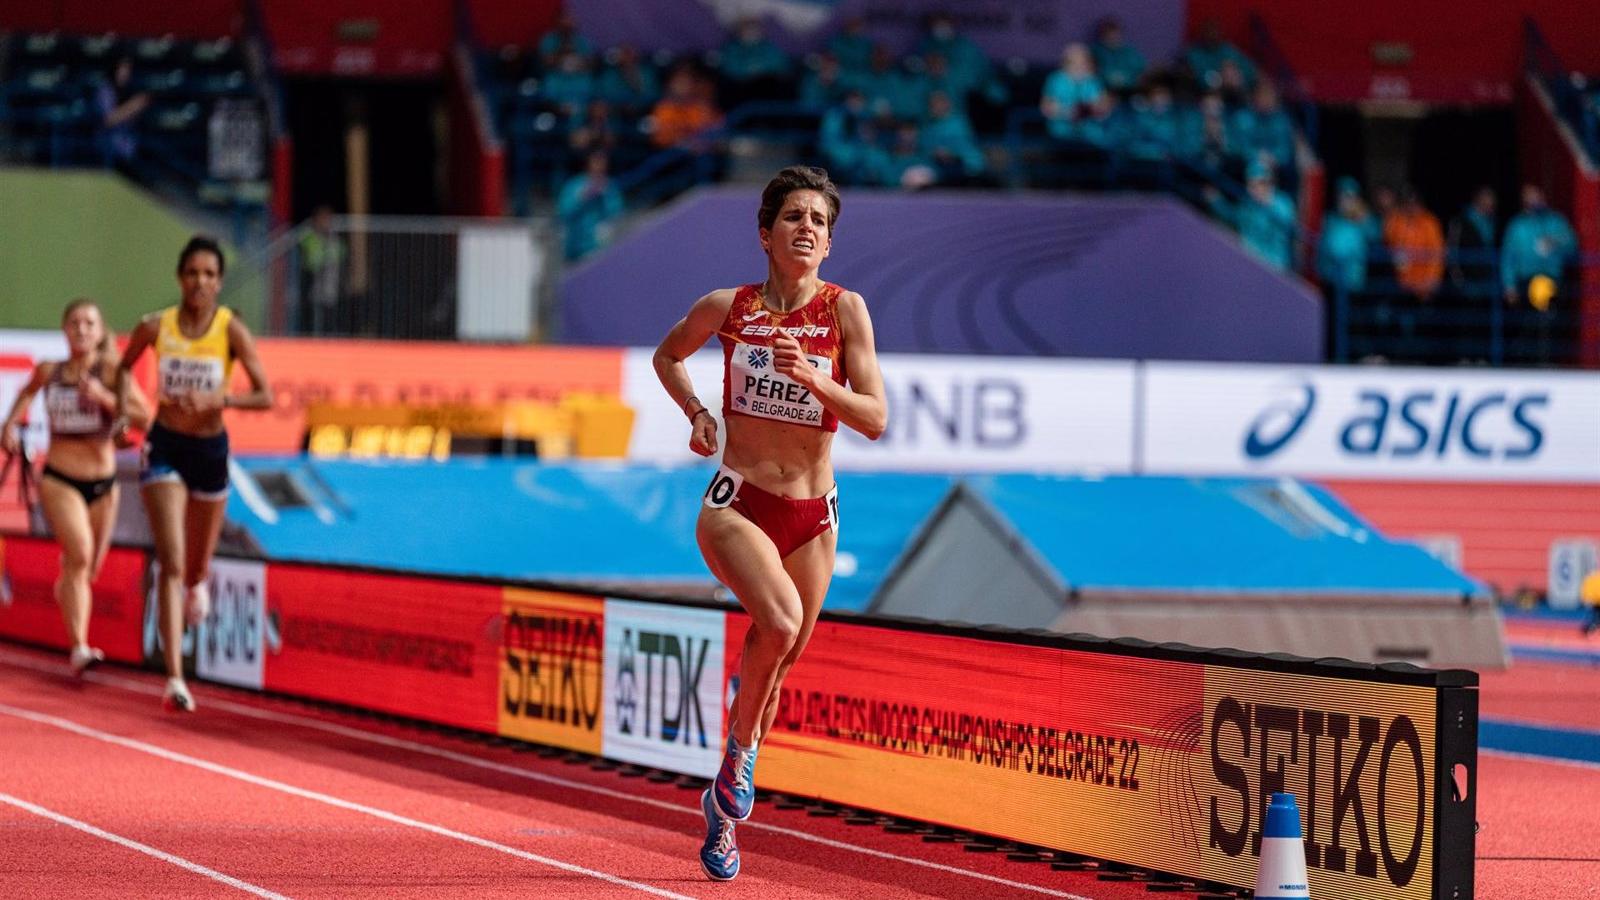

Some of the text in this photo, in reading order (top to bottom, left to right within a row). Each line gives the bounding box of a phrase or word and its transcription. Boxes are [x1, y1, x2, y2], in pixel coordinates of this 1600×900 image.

[744, 374, 811, 405] PÉREZ
[751, 400, 819, 422] BELGRADE 22
[504, 609, 599, 732] SEIKO
[638, 630, 711, 749] TDK
[805, 691, 866, 741] ATHLETICS
[868, 699, 919, 751] INDOOR
[922, 707, 1034, 773] CHAMPIONSHIPS
[1037, 726, 1115, 788] BELGRADE
[1118, 737, 1140, 791] 22
[1209, 696, 1426, 889] SEIKO
